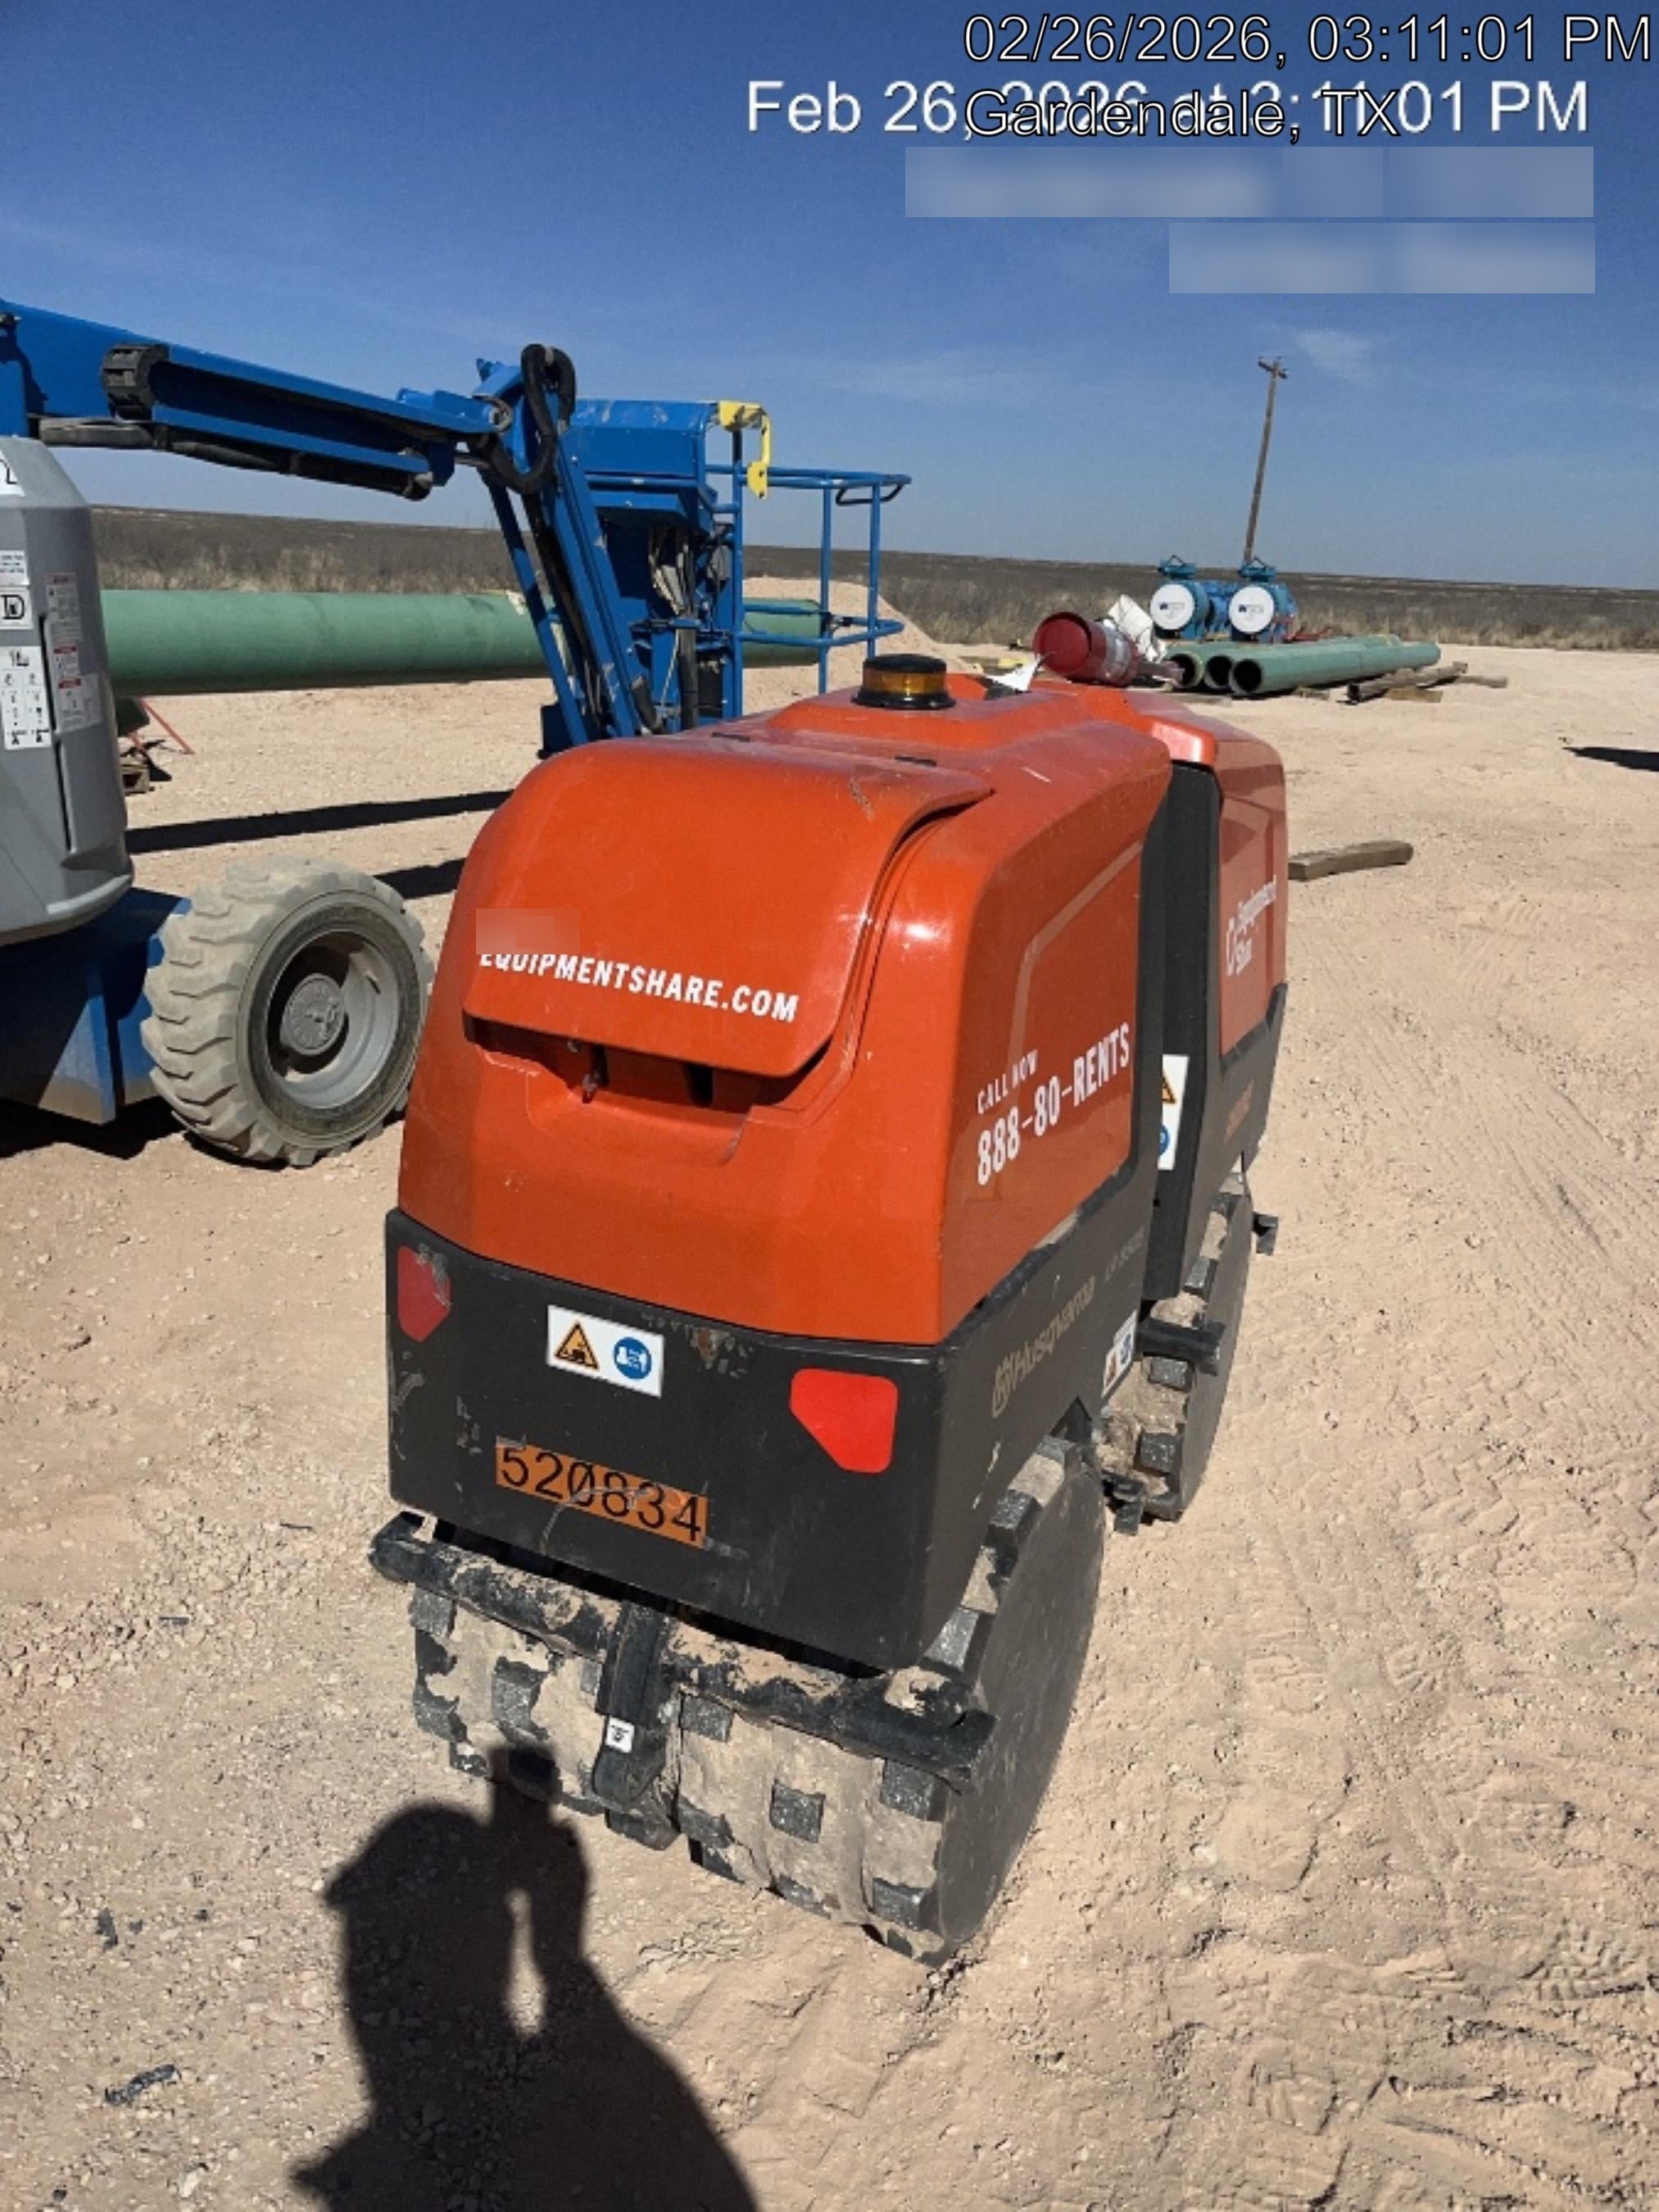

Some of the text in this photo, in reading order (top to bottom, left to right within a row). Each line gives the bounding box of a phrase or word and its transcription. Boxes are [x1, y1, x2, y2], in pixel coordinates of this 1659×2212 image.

[977, 1073, 1009, 1115] CALL
[977, 1021, 1131, 1185] 888-80-RENTS
[502, 1447, 701, 1542] 520834
